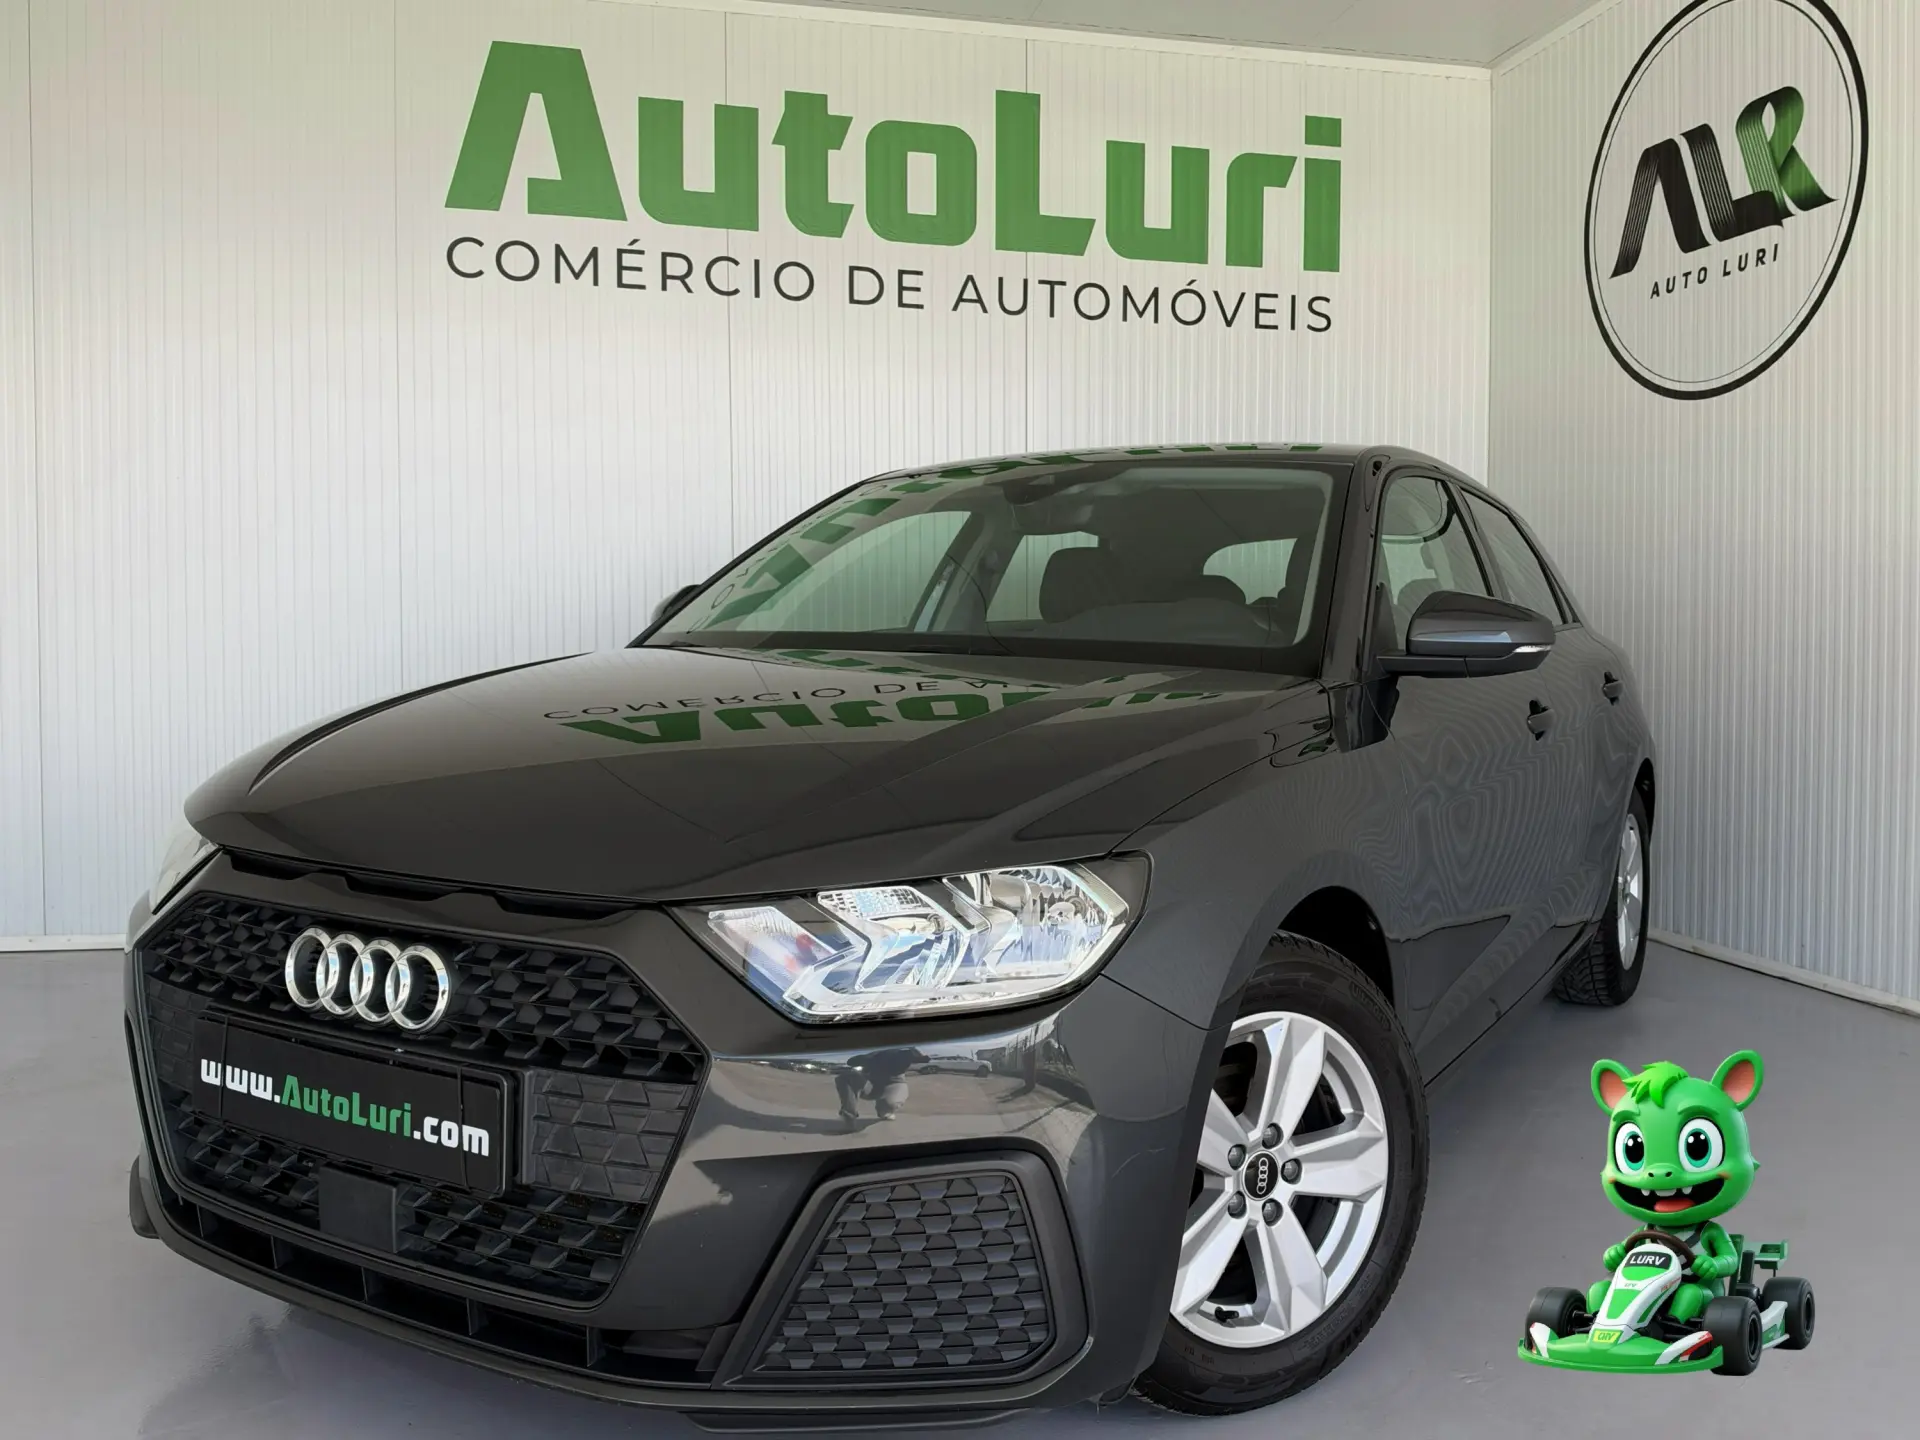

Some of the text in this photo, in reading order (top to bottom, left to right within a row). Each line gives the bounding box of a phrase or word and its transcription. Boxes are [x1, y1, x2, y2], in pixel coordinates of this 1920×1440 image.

[446, 41, 1341, 272] AutoLuri
[446, 236, 1333, 333] COMÉRCIO DE AUTOMÓVEIS
[1650, 243, 1779, 300] AUTO LURI
[200, 1058, 490, 1157] www.AutoLuri.com
